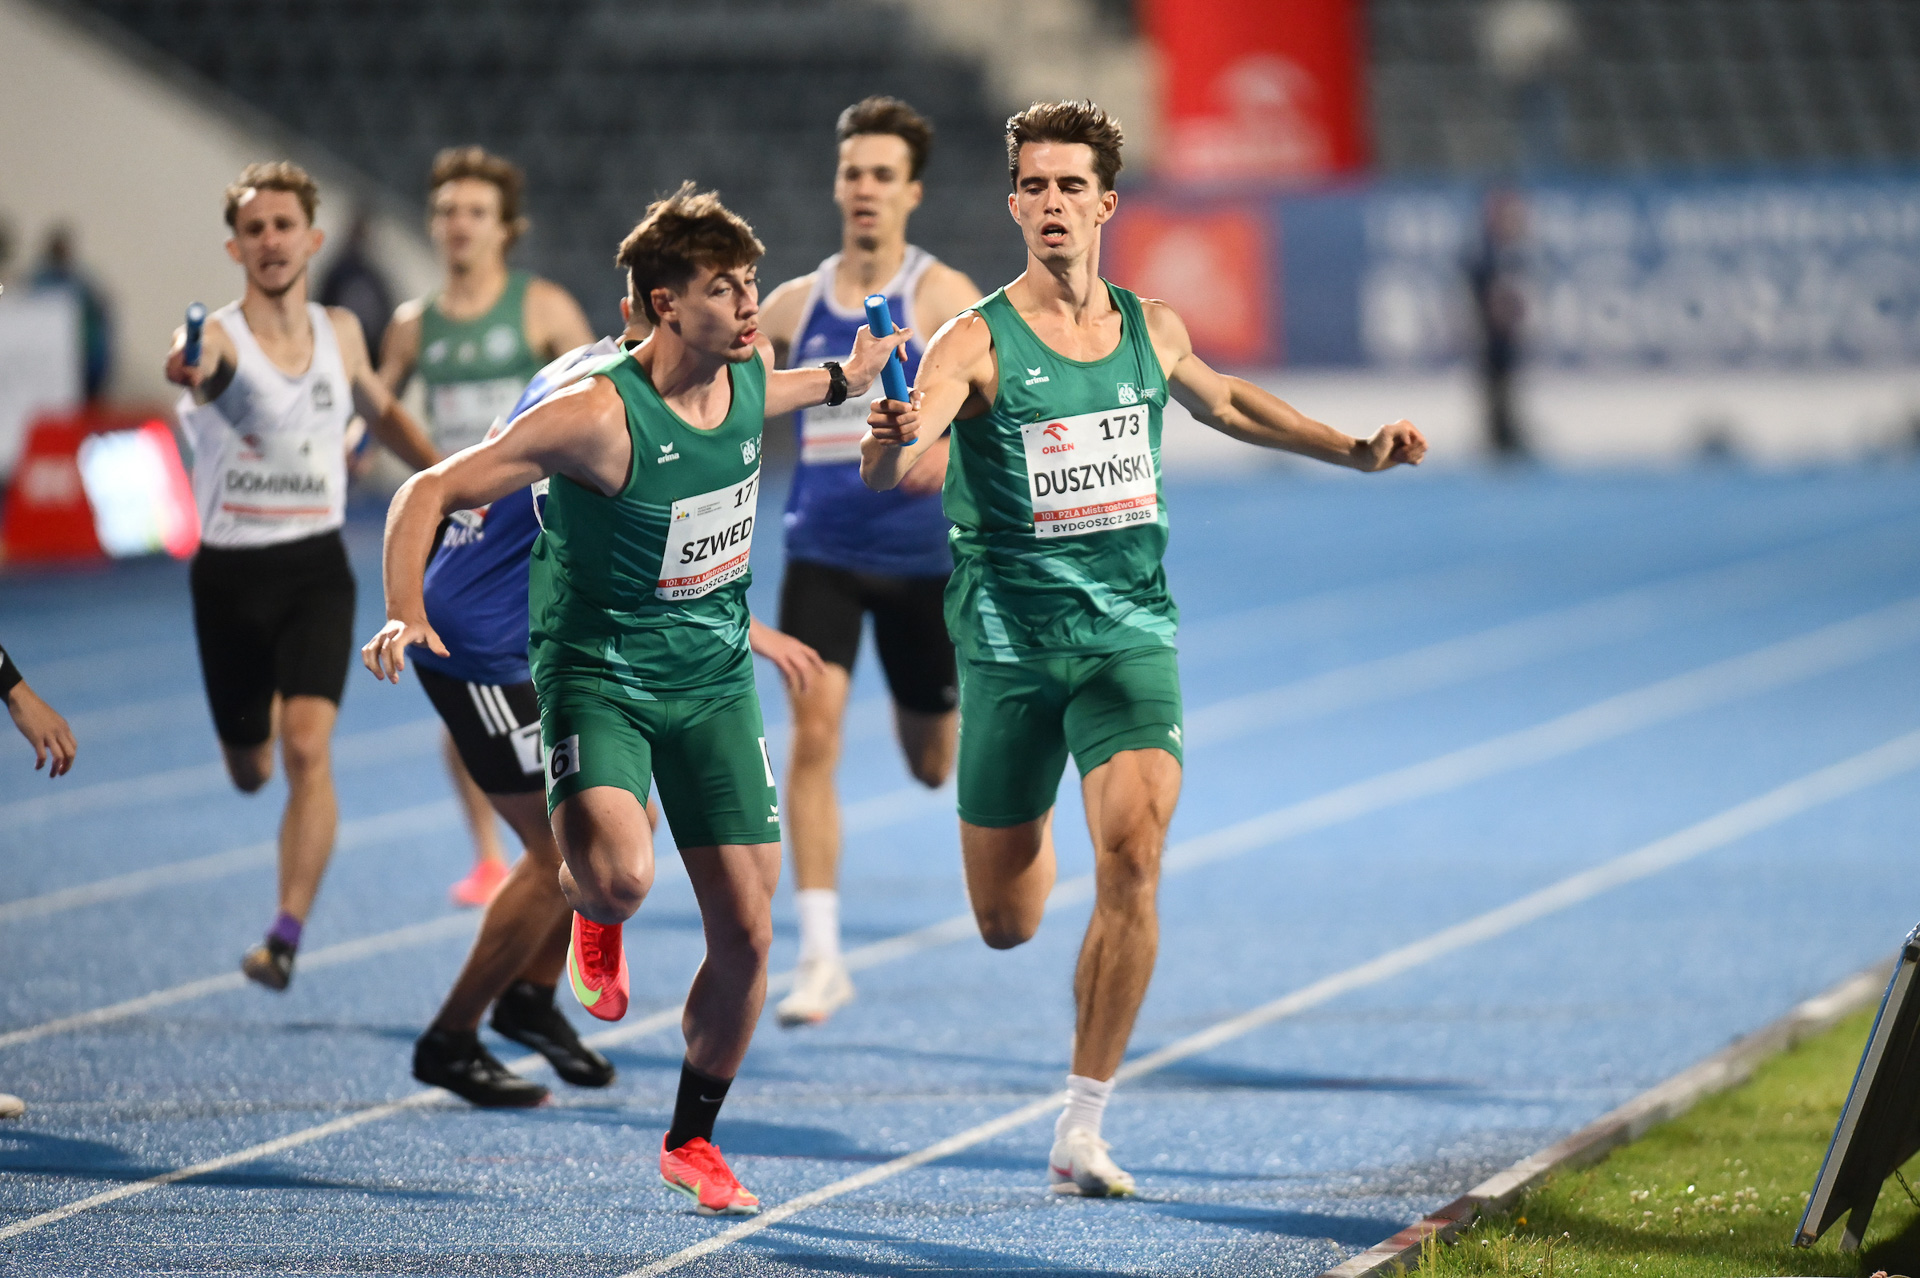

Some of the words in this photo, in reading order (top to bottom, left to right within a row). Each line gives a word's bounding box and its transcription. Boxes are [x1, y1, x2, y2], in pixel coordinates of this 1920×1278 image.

[1025, 375, 1050, 386] erima
[1099, 413, 1140, 441] 173
[657, 452, 680, 465] erima
[1042, 443, 1075, 455] ORLEN
[1034, 454, 1151, 497] DUSZYŃSKI
[1041, 512, 1057, 521] 101.
[1058, 509, 1081, 519] PZLA
[1082, 500, 1134, 516] Mistrzostwa
[1052, 515, 1123, 533] BYDGOSZCZ
[1125, 510, 1152, 521] 2025
[679, 516, 753, 564] SZWED
[665, 579, 679, 587] 101.
[681, 576, 701, 585] PZLA
[702, 559, 740, 581] Mistrzostwa
[672, 572, 729, 598] BYDGOSZCZ
[550, 743, 570, 780] 6
